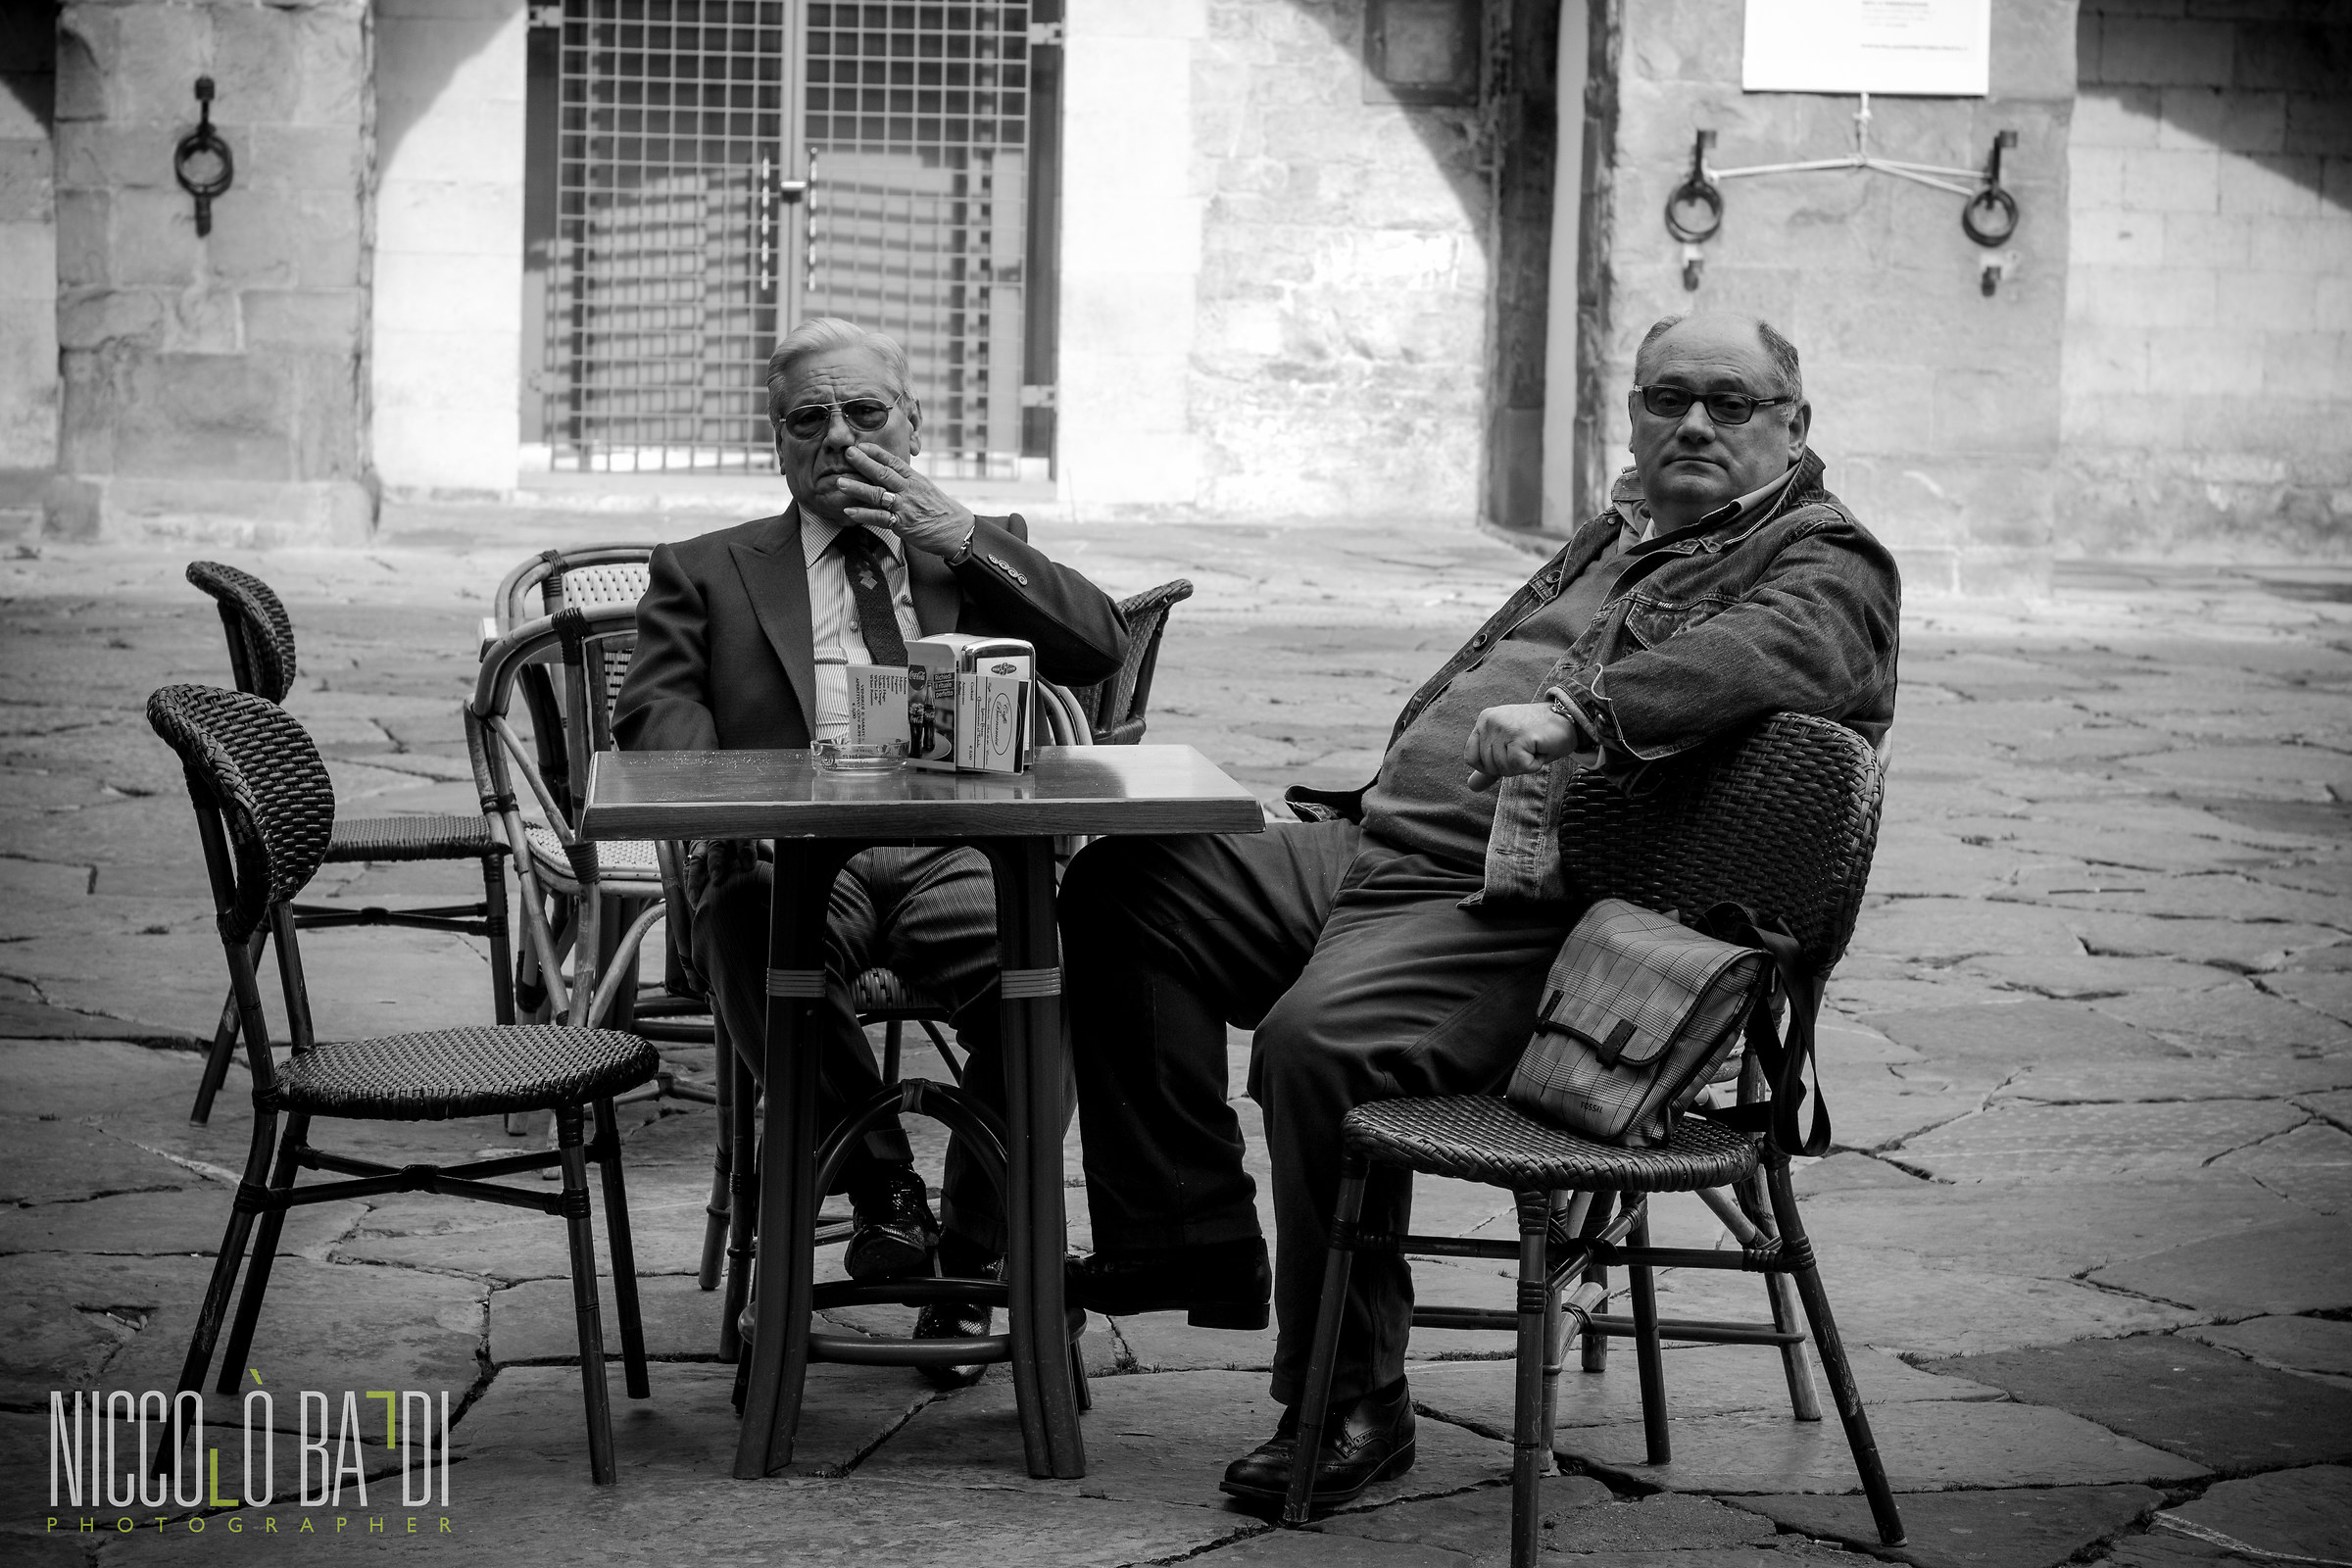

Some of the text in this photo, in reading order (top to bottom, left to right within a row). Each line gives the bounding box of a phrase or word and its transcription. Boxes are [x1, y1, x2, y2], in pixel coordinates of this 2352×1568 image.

[934, 672, 953, 681] Richiedi
[939, 681, 953, 690] rituale
[935, 689, 954, 699] perfetto
[1580, 1101, 1603, 1114] FOSSIL
